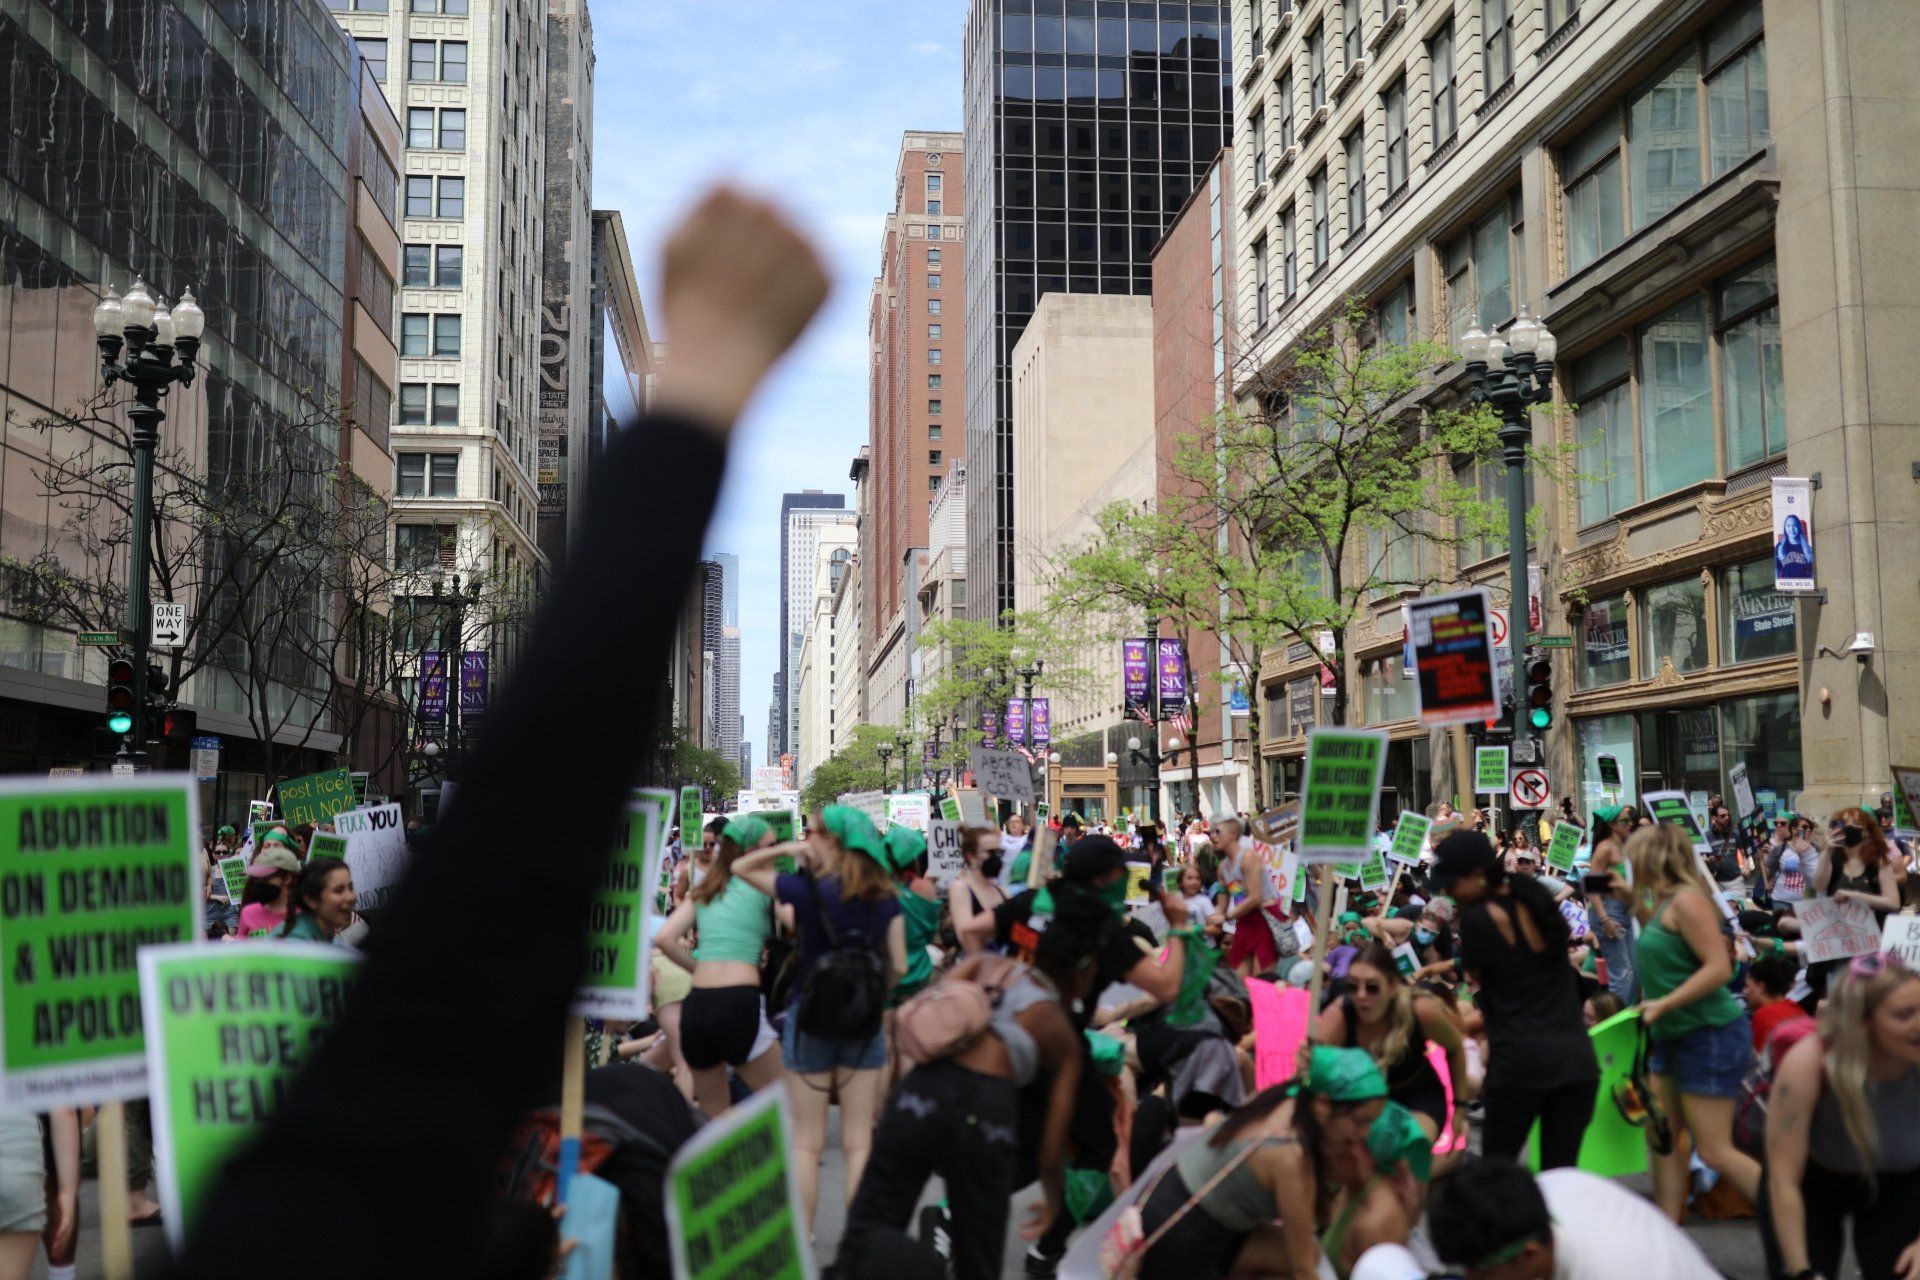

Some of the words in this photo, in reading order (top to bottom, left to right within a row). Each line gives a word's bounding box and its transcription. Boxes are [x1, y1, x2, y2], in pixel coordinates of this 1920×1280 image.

[541, 391, 567, 400] STATE
[156, 606, 182, 617] ONE
[156, 618, 182, 628] WAY
[1753, 618, 1772, 632] State
[1772, 615, 1794, 629] Street
[19, 802, 170, 853] ABORTION
[338, 813, 368, 834] FUCK
[367, 809, 398, 831] YOU
[2, 870, 45, 919] ON
[59, 862, 187, 915] DEMAND
[14, 942, 35, 984] &
[49, 922, 182, 980] WITH
[34, 990, 146, 1050] APOLO
[220, 1022, 299, 1070] ROE
